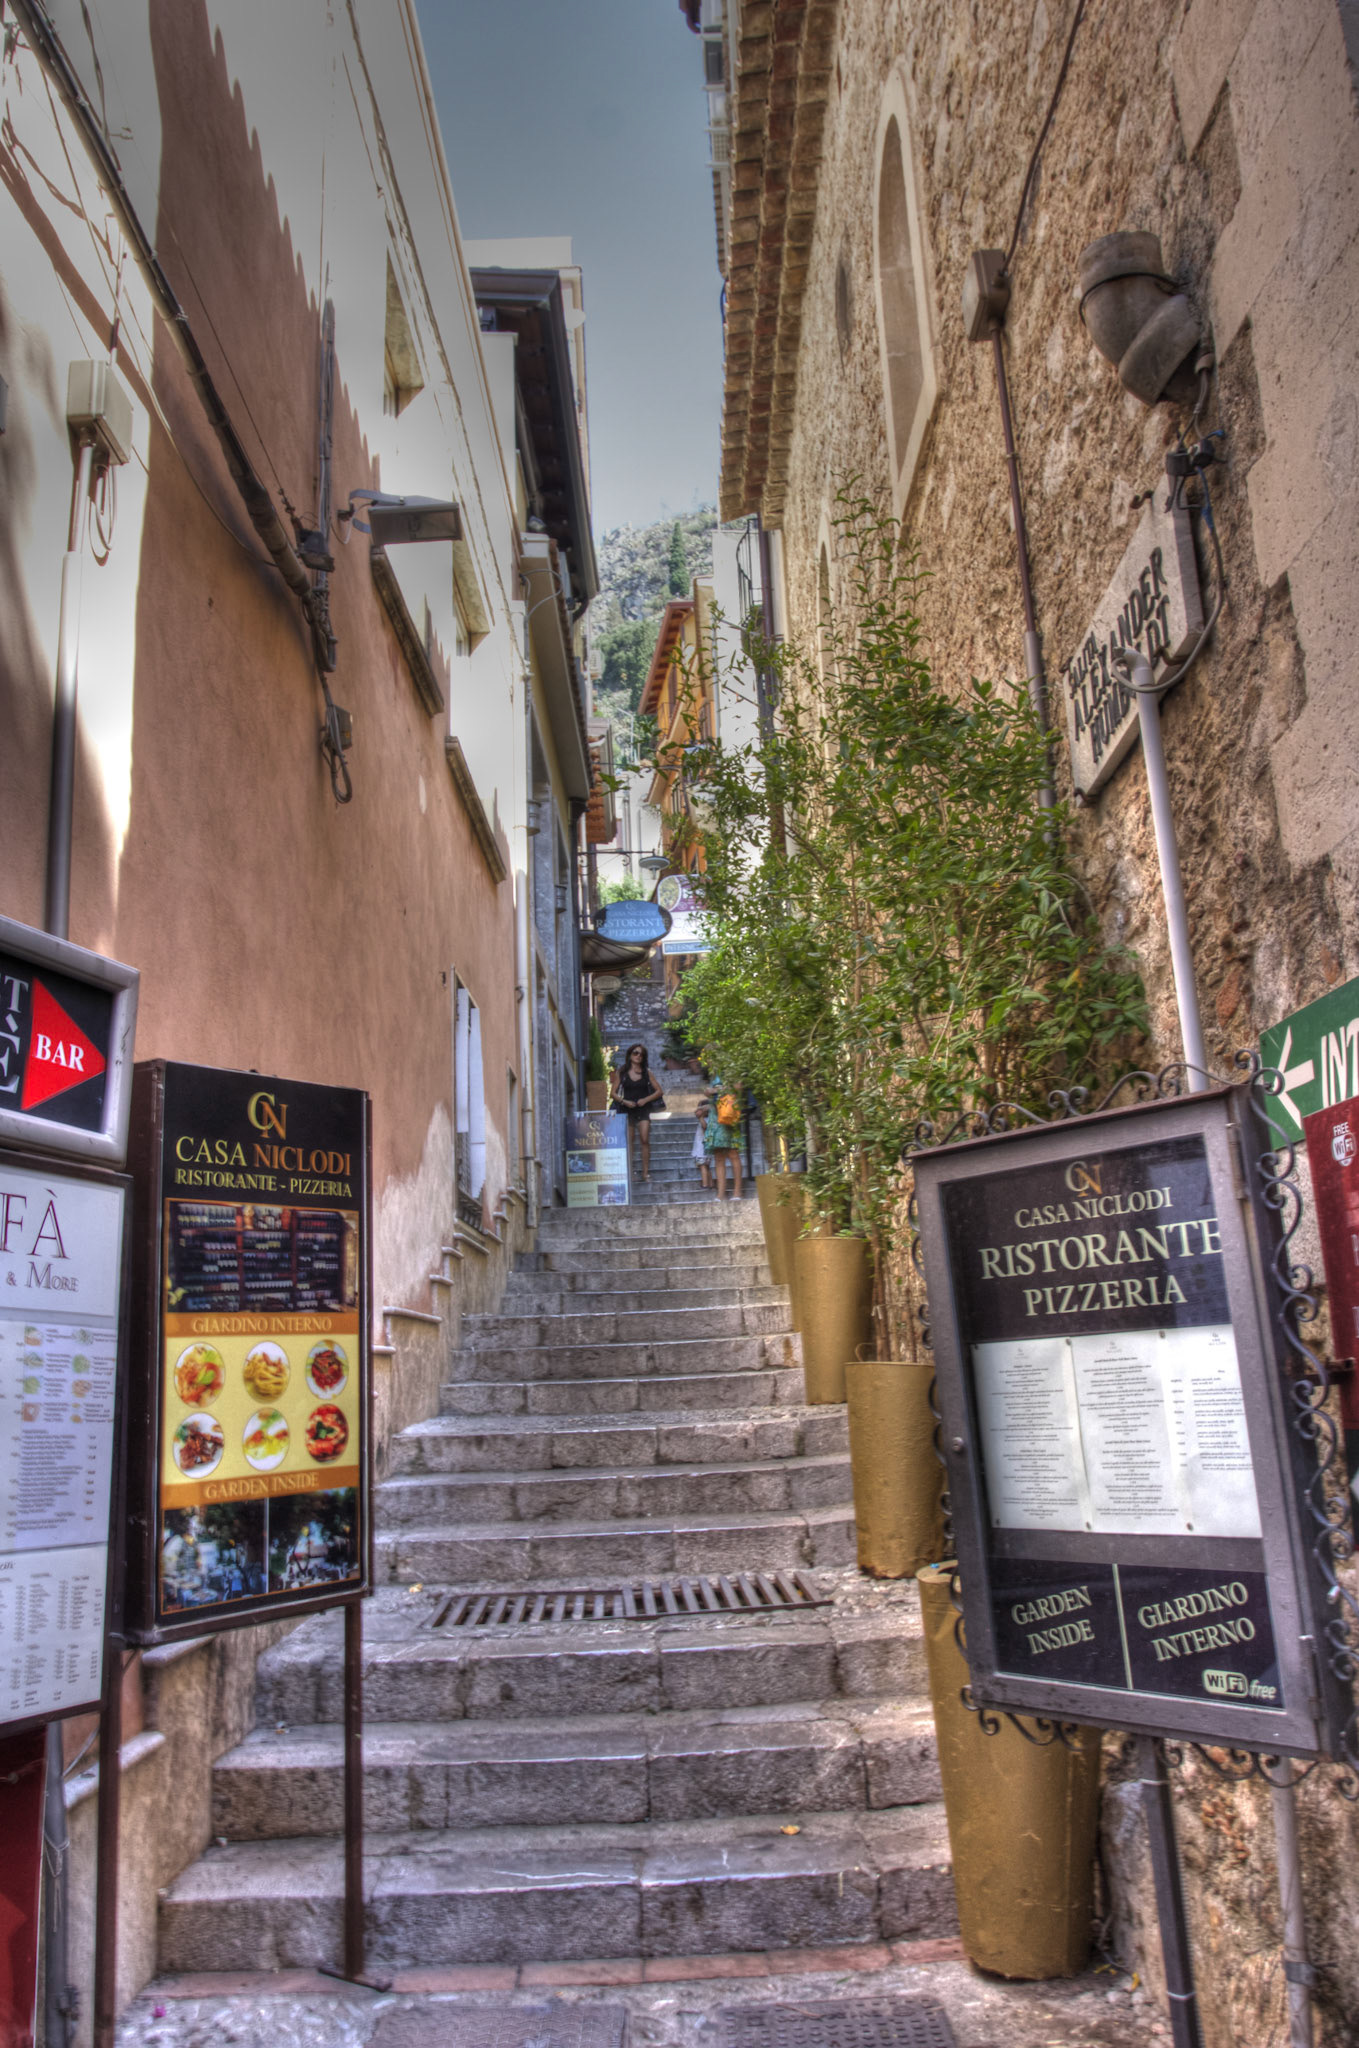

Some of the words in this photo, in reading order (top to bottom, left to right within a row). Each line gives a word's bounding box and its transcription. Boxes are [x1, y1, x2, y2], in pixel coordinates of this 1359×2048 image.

[1073, 546, 1168, 742] ALEXANDER
[596, 917, 670, 929] RISTORANTE
[608, 927, 658, 938] PIZZERIA
[35, 1033, 85, 1073] BAR
[575, 1136, 618, 1146] NICLODI
[1333, 1121, 1350, 1136] FREE
[175, 1135, 248, 1168] CASA
[253, 1143, 352, 1176] NICLODI
[174, 1167, 278, 1192] RISTORANTE
[289, 1178, 353, 1198] PIZZERIA
[1014, 1207, 1070, 1229] CASA
[1073, 1186, 1174, 1221] NICLODI
[978, 1217, 1224, 1280] RISTORANTE
[1023, 1274, 1189, 1317] PIZZERIA
[192, 1316, 269, 1334] GIARDINO
[270, 1316, 333, 1333] INTERNO
[204, 1477, 270, 1500] GARDEN
[270, 1471, 321, 1492] INSIDE
[1010, 1585, 1094, 1627] GARDEN
[1137, 1581, 1249, 1630] GIARDINO
[1026, 1619, 1096, 1655] INSIDE
[1150, 1617, 1256, 1663] INTERNO
[1249, 1678, 1278, 1701] free
